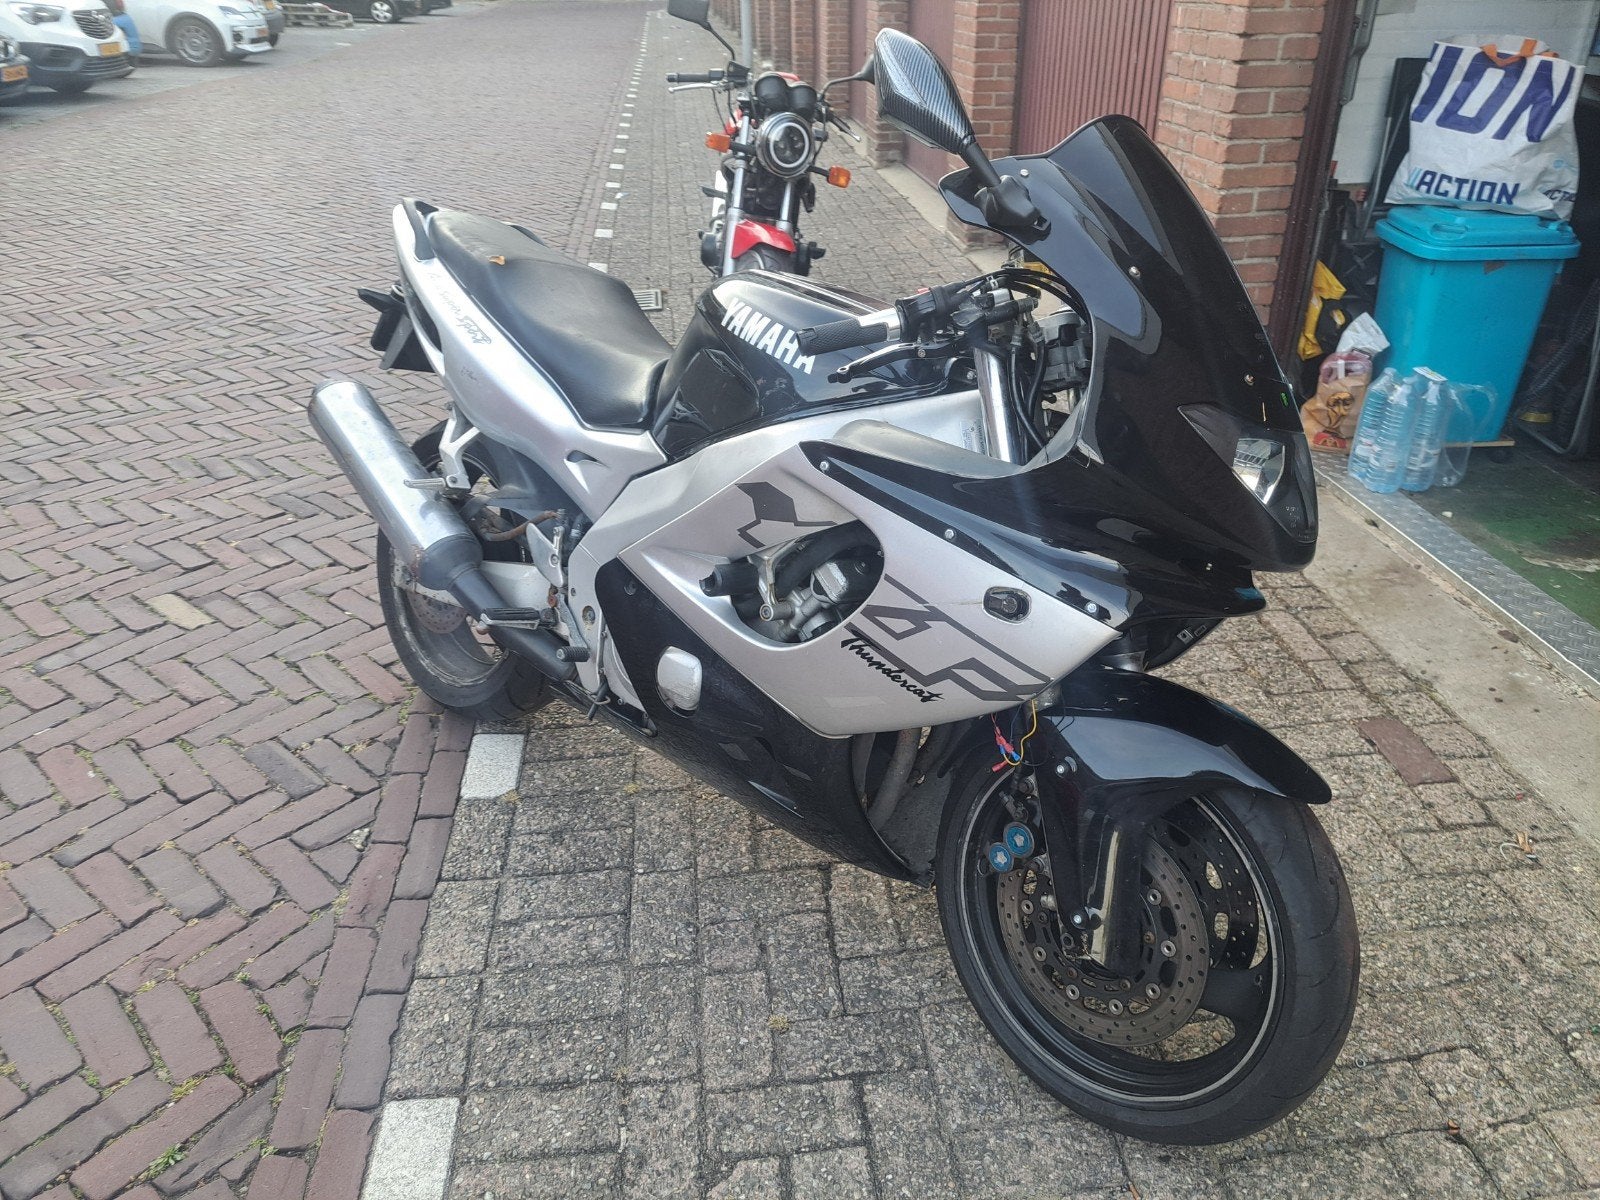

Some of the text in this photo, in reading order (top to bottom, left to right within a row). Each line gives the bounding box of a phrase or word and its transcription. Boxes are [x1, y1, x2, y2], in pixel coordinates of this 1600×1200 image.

[1411, 43, 1576, 142] ION
[1416, 170, 1520, 205] ACTION
[840, 629, 944, 703] Thundercat
